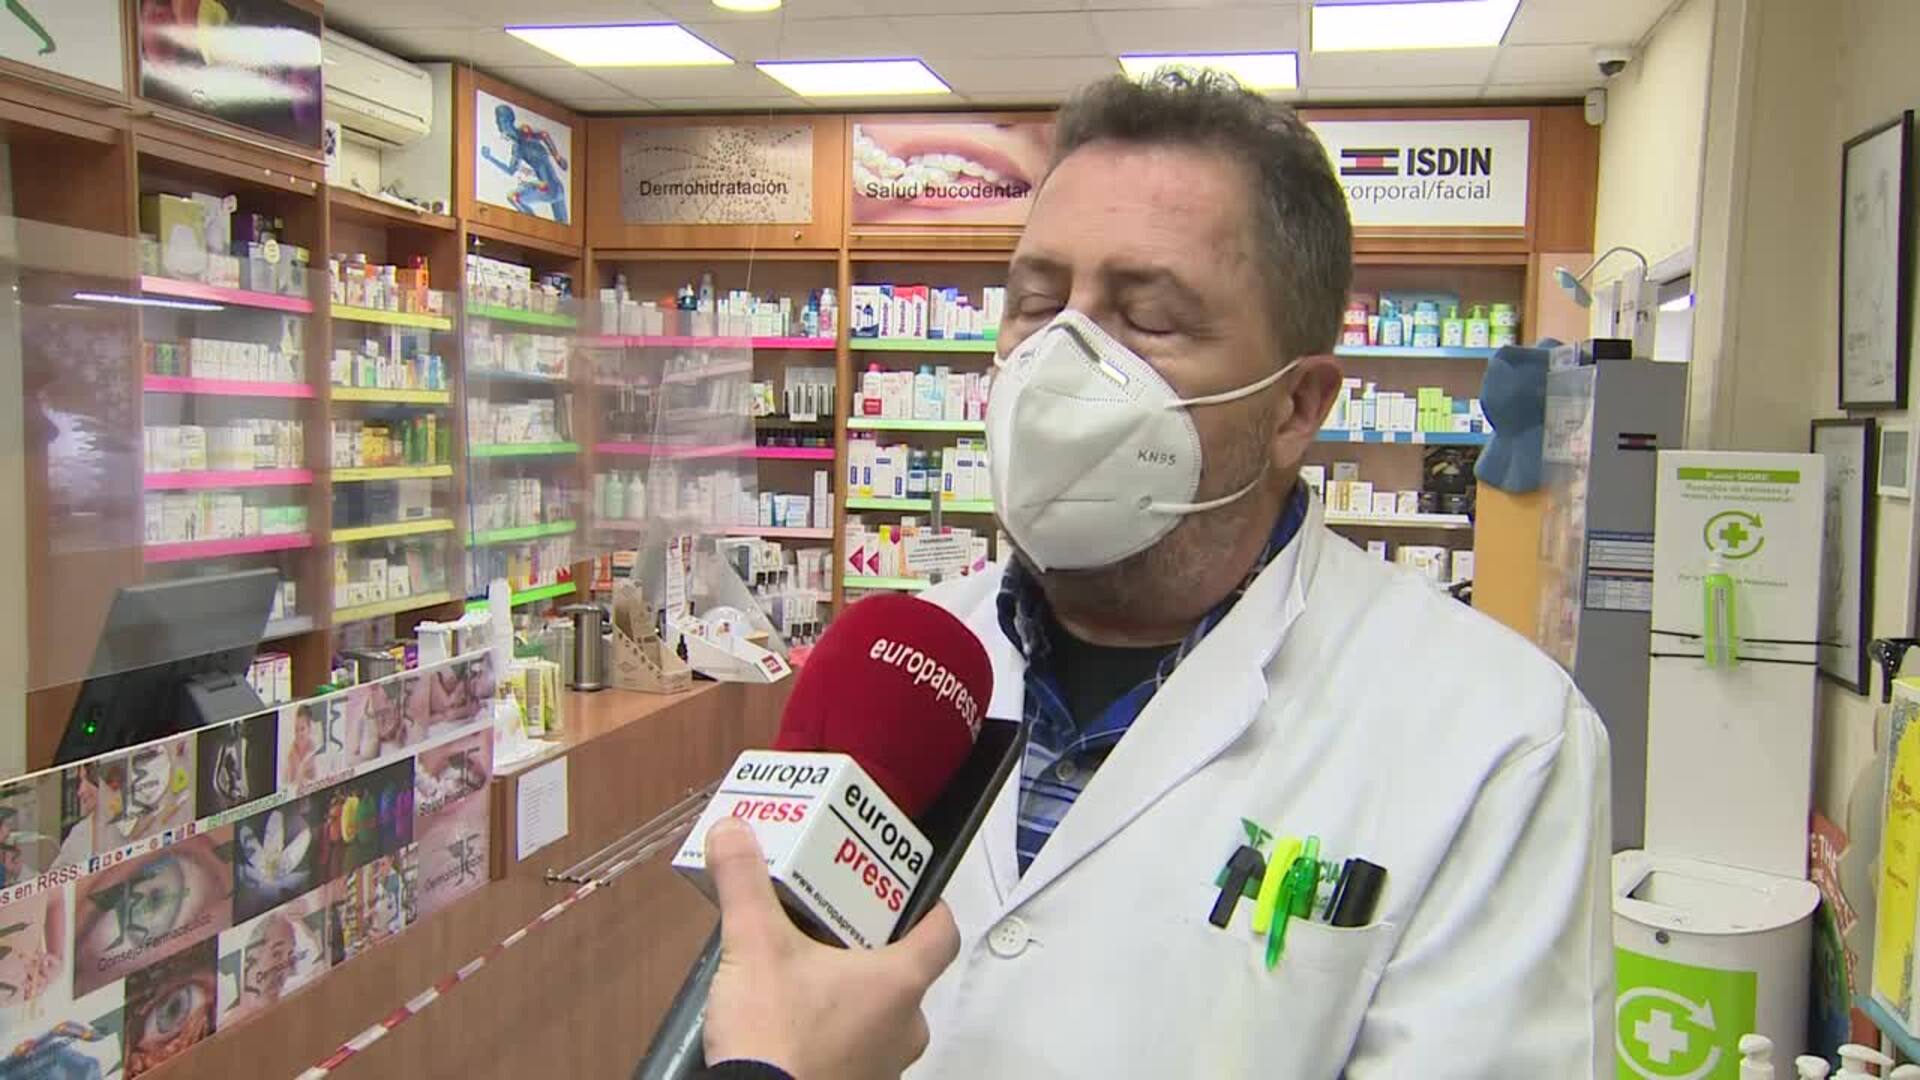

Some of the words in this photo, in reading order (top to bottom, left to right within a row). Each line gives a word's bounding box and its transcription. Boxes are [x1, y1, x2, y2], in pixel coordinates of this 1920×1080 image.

[1407, 148, 1491, 176] ISDIN
[639, 180, 788, 196] Dermohidratación
[866, 182, 918, 198] Salud
[924, 182, 1030, 198] bucodental
[1343, 180, 1491, 204] corporal/facial
[1137, 449, 1176, 466] KN95
[736, 761, 830, 789] europa
[732, 798, 809, 824] press
[844, 782, 924, 875] europa
[15, 882, 32, 900] en
[37, 862, 83, 892] RRSS:
[834, 837, 905, 913] press
